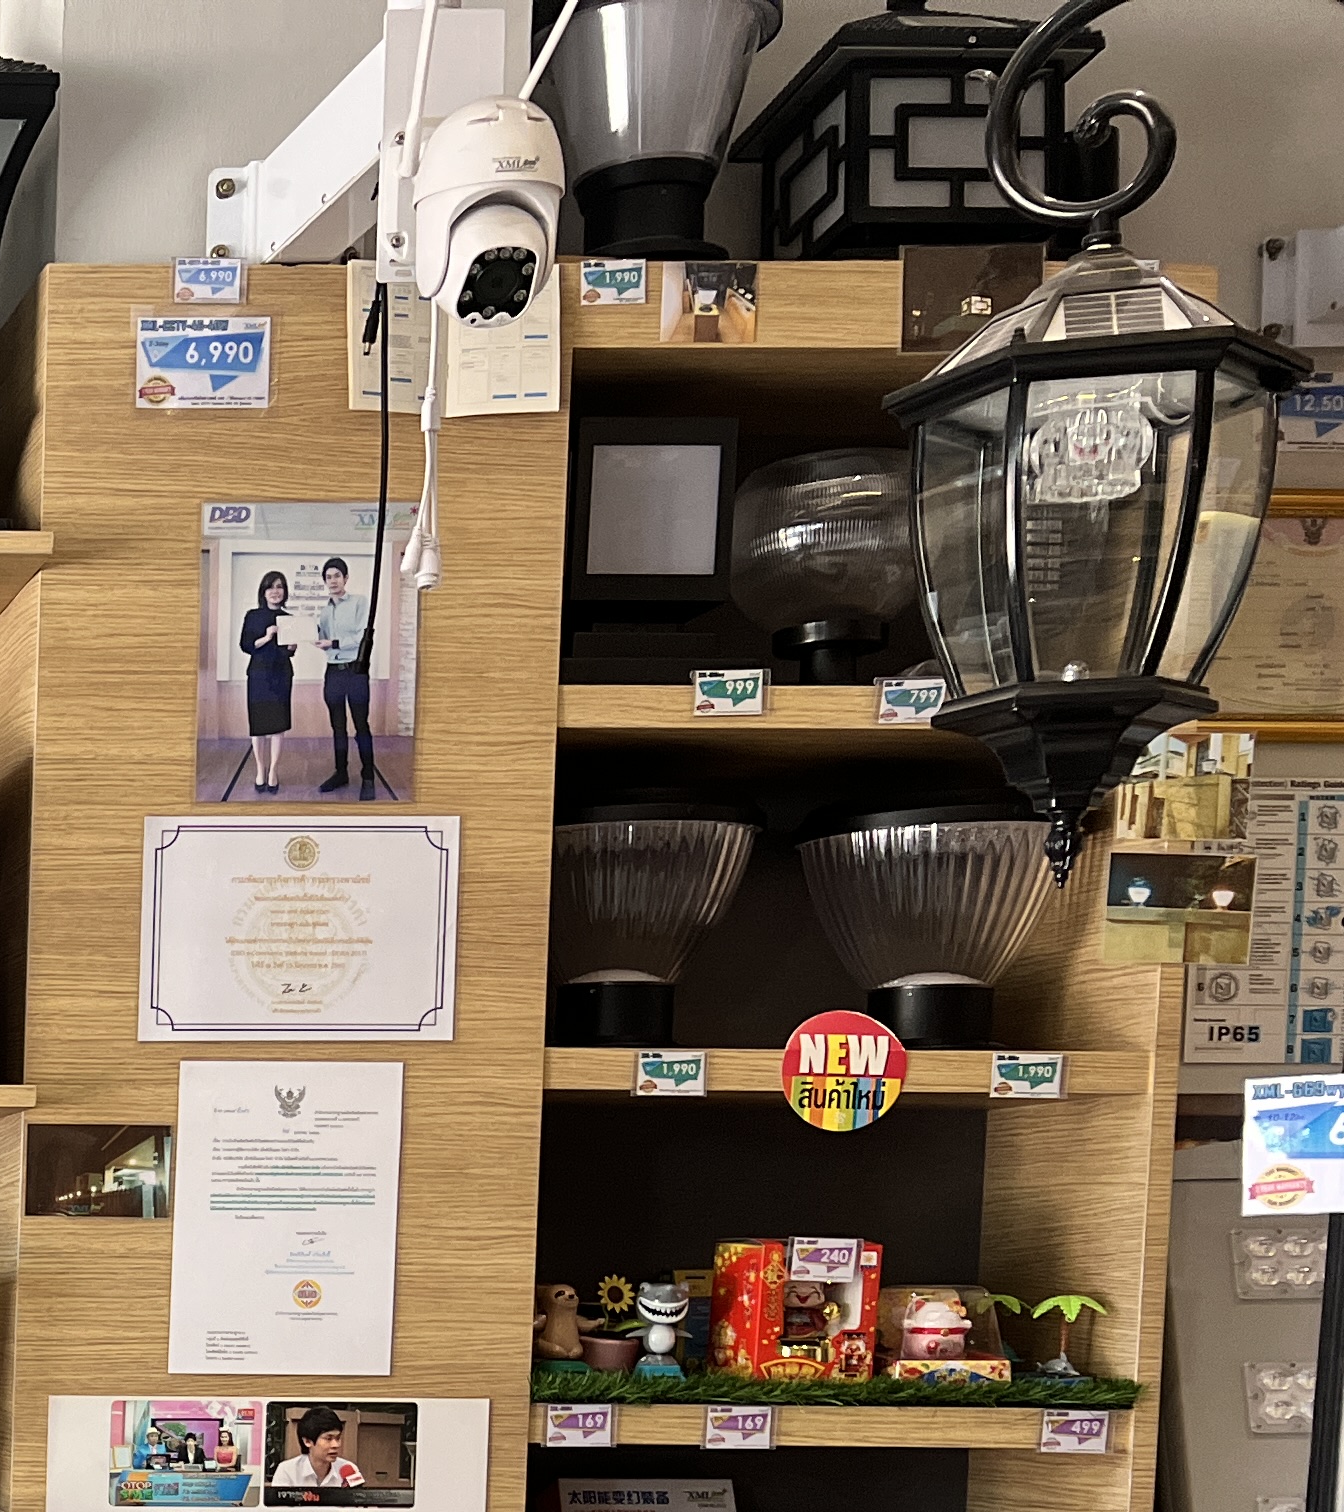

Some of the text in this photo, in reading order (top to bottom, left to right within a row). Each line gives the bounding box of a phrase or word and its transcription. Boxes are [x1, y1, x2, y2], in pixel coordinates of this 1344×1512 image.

[199, 270, 232, 283] 6,990
[605, 271, 638, 284] 1,990
[185, 341, 254, 366] 6,990
[725, 681, 754, 695] 999
[910, 690, 937, 703] 799
[1208, 1025, 1261, 1043] IP65
[799, 1033, 891, 1076] NEW
[662, 1063, 697, 1076] 1,990
[1018, 1065, 1052, 1078] 1,990
[797, 1079, 886, 1113] สินค้าใหม่
[821, 1249, 849, 1263] 240
[577, 1414, 604, 1427] 169
[737, 1416, 763, 1430] 169
[1071, 1420, 1100, 1434] 499
